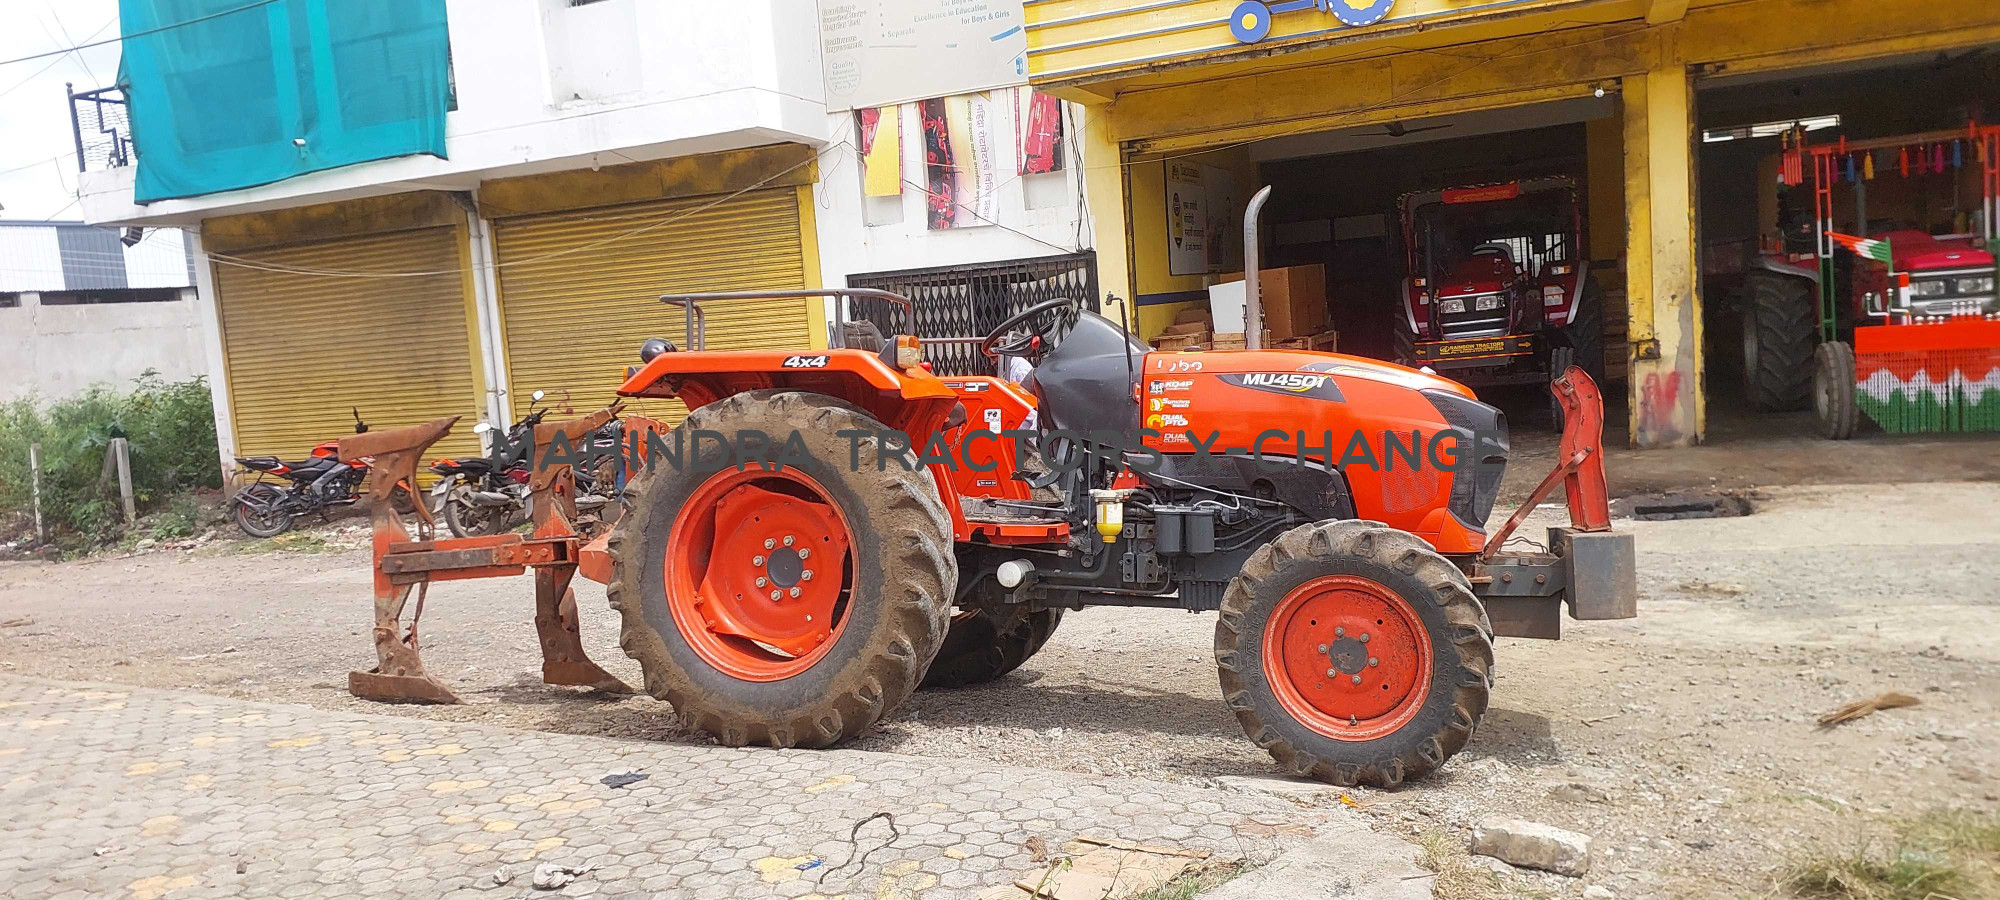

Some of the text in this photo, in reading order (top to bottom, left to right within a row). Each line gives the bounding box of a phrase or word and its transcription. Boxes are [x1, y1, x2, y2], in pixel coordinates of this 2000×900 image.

[955, 4, 988, 15] Education
[971, 15, 987, 24] Boys
[994, 10, 1010, 19] Girls
[783, 355, 827, 368] 4x4
